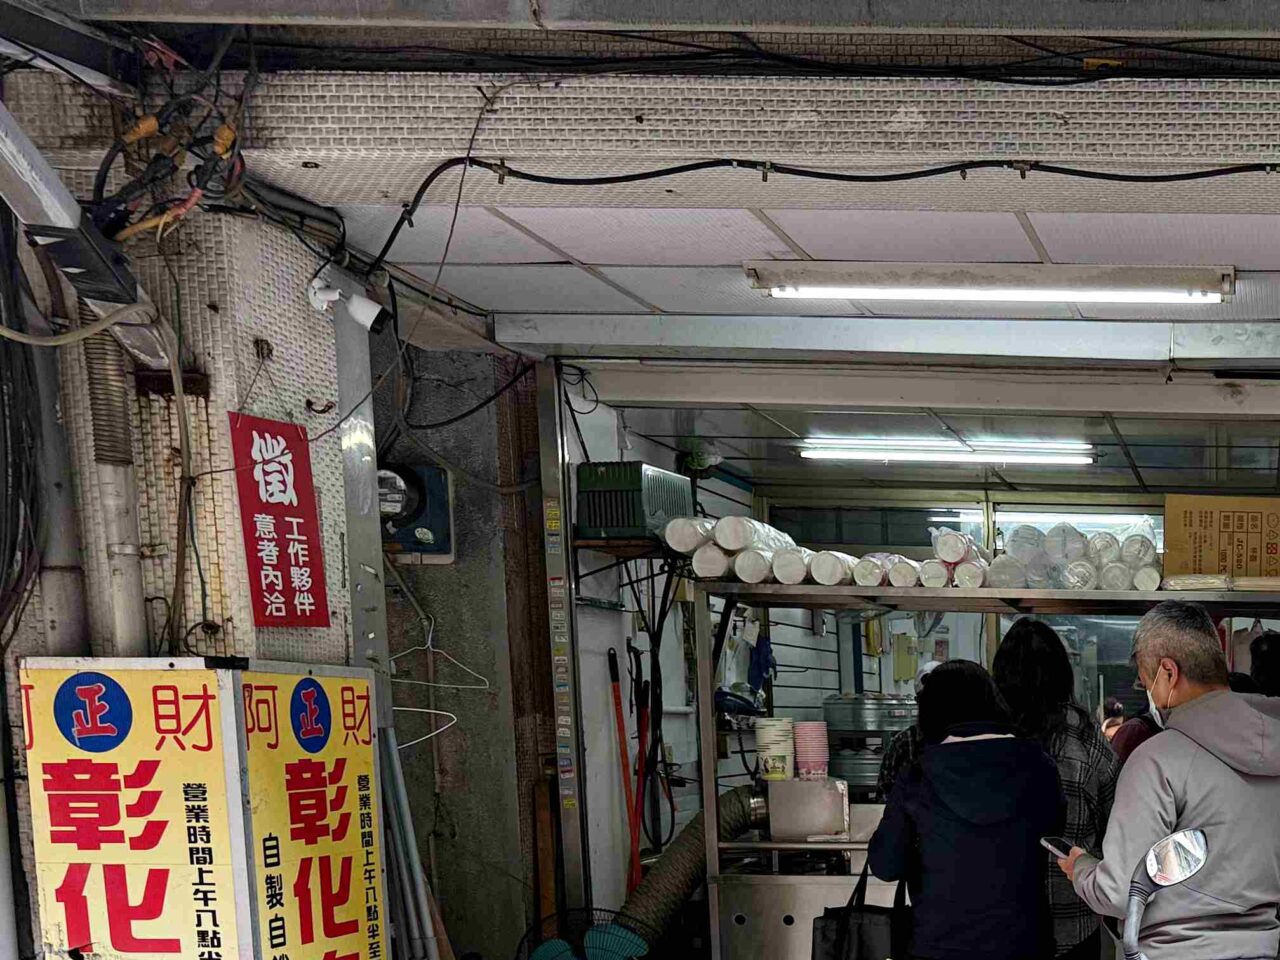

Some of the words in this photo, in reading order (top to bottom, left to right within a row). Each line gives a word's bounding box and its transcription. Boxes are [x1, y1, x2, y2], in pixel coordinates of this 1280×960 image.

[251, 430, 298, 507] 徵
[253, 513, 286, 617] 意者內洽
[284, 516, 316, 617] 工作夥伴
